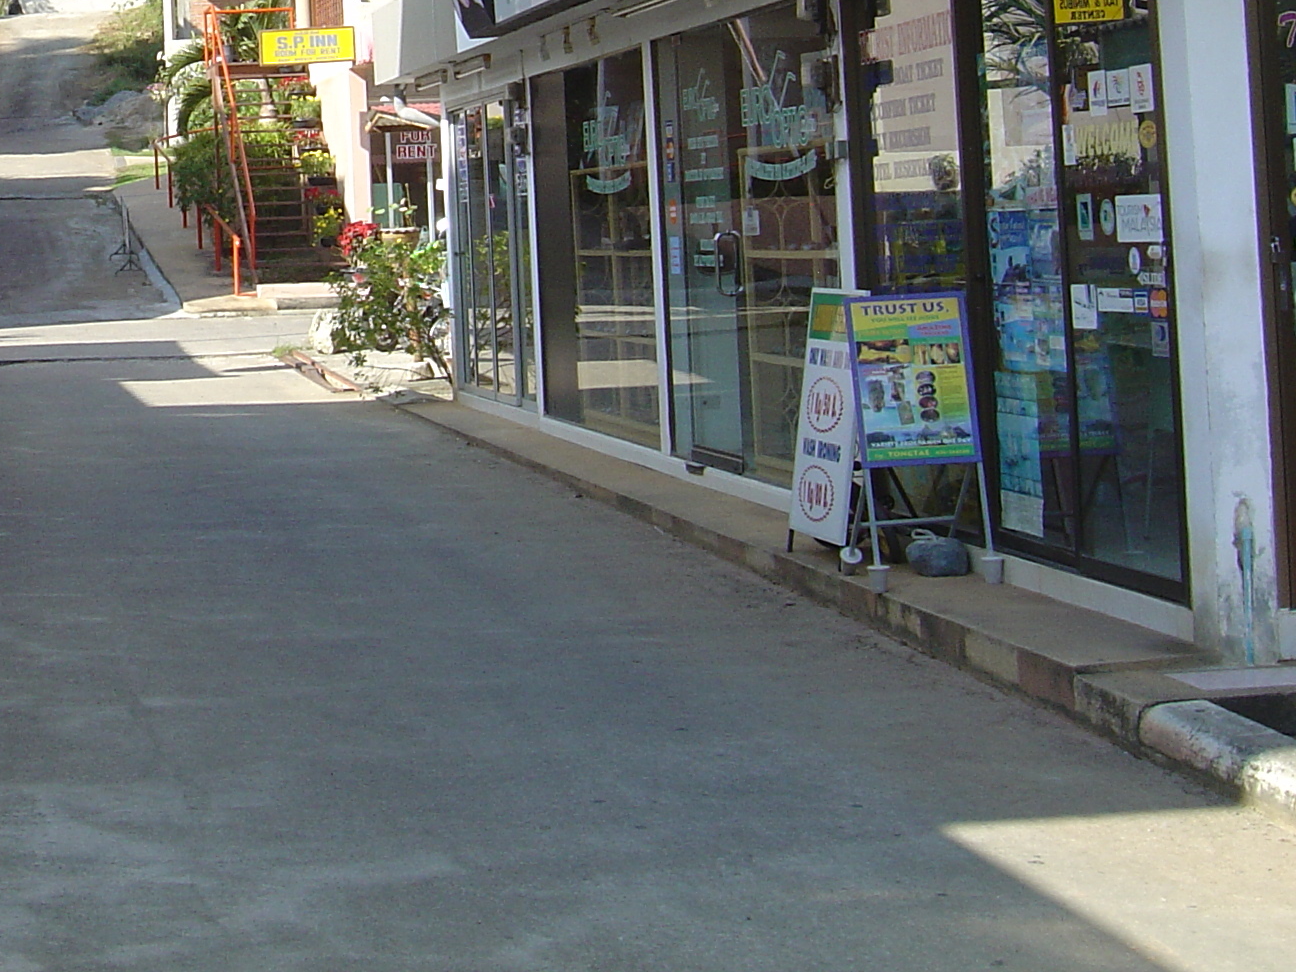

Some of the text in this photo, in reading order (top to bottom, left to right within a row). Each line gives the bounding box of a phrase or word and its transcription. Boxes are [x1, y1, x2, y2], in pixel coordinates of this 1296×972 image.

[276, 34, 338, 50] S.P. INN
[320, 46, 341, 56] RENT
[739, 84, 779, 128] EURO
[399, 130, 432, 143] FOR
[396, 143, 437, 160] RENT
[860, 302, 918, 316] TRUST
